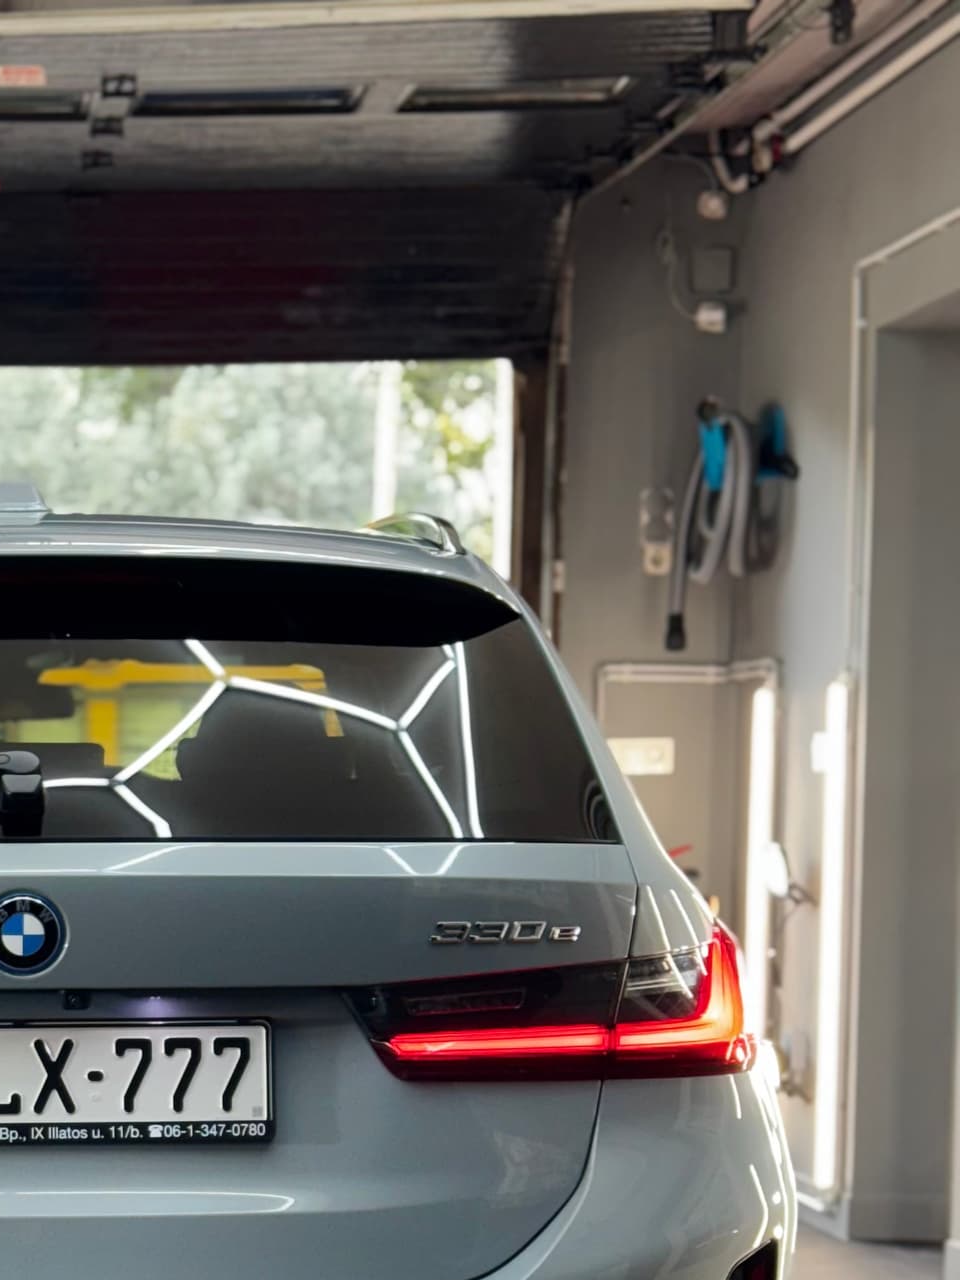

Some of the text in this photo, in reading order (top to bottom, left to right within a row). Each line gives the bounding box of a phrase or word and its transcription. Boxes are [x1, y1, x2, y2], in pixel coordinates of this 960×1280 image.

[430, 920, 581, 943] 330e
[0, 1127, 27, 1142] Bp.,
[31, 1127, 44, 1139] IX
[92, 1127, 104, 1138] u.
[110, 1124, 143, 1138] 11/b.
[163, 1123, 266, 1137] 06-1-347-0780
